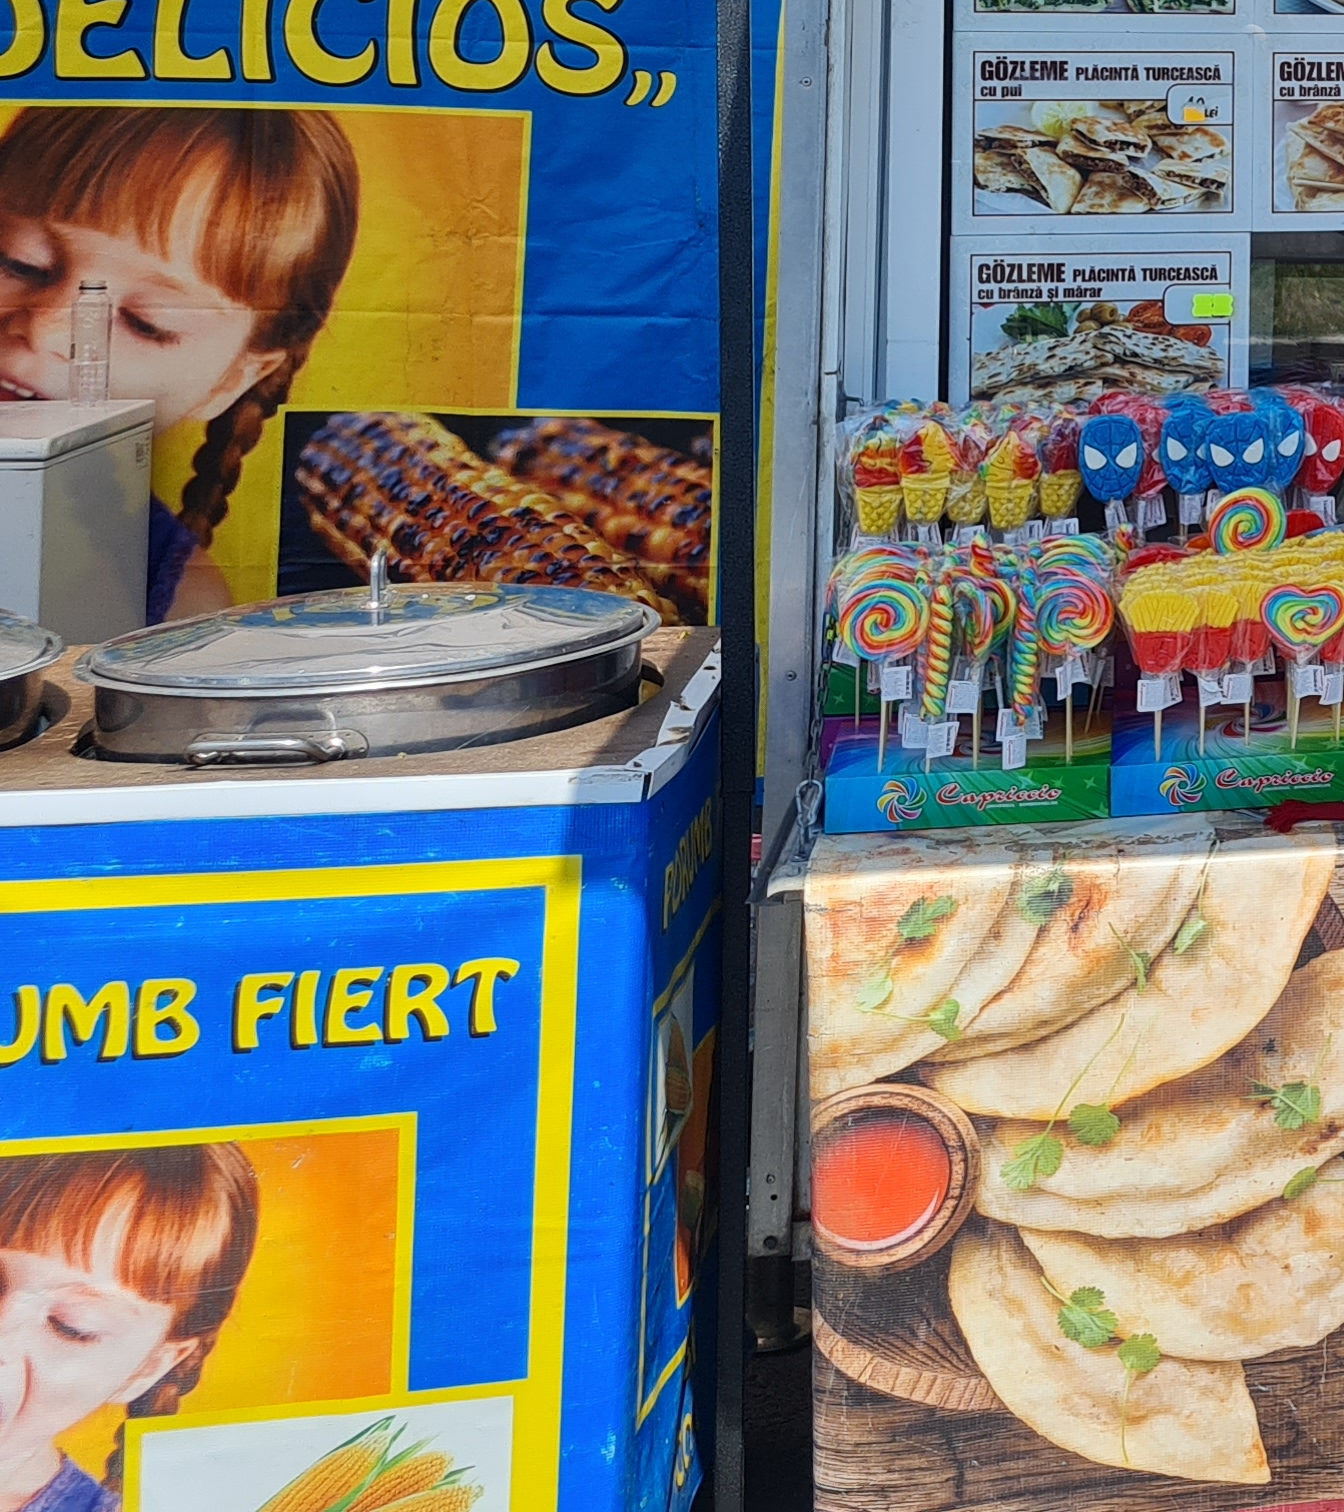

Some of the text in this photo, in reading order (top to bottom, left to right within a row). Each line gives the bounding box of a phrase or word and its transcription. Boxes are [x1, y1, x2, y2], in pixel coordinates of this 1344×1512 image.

[981, 56, 1221, 82] GÖZLEME PLĂCINTĂ TURCEASCĂ
[981, 84, 1022, 98] cu pui
[1279, 84, 1341, 97] cu brânză
[978, 259, 1218, 284] GÖZLEME PLĂCINTĂ TURCEASCĂ
[978, 286, 1102, 300] cu brânză mărar
[1215, 766, 1335, 794] Capriccio
[936, 782, 1062, 810] Capriccio
[231, 957, 521, 1052] FIERT
